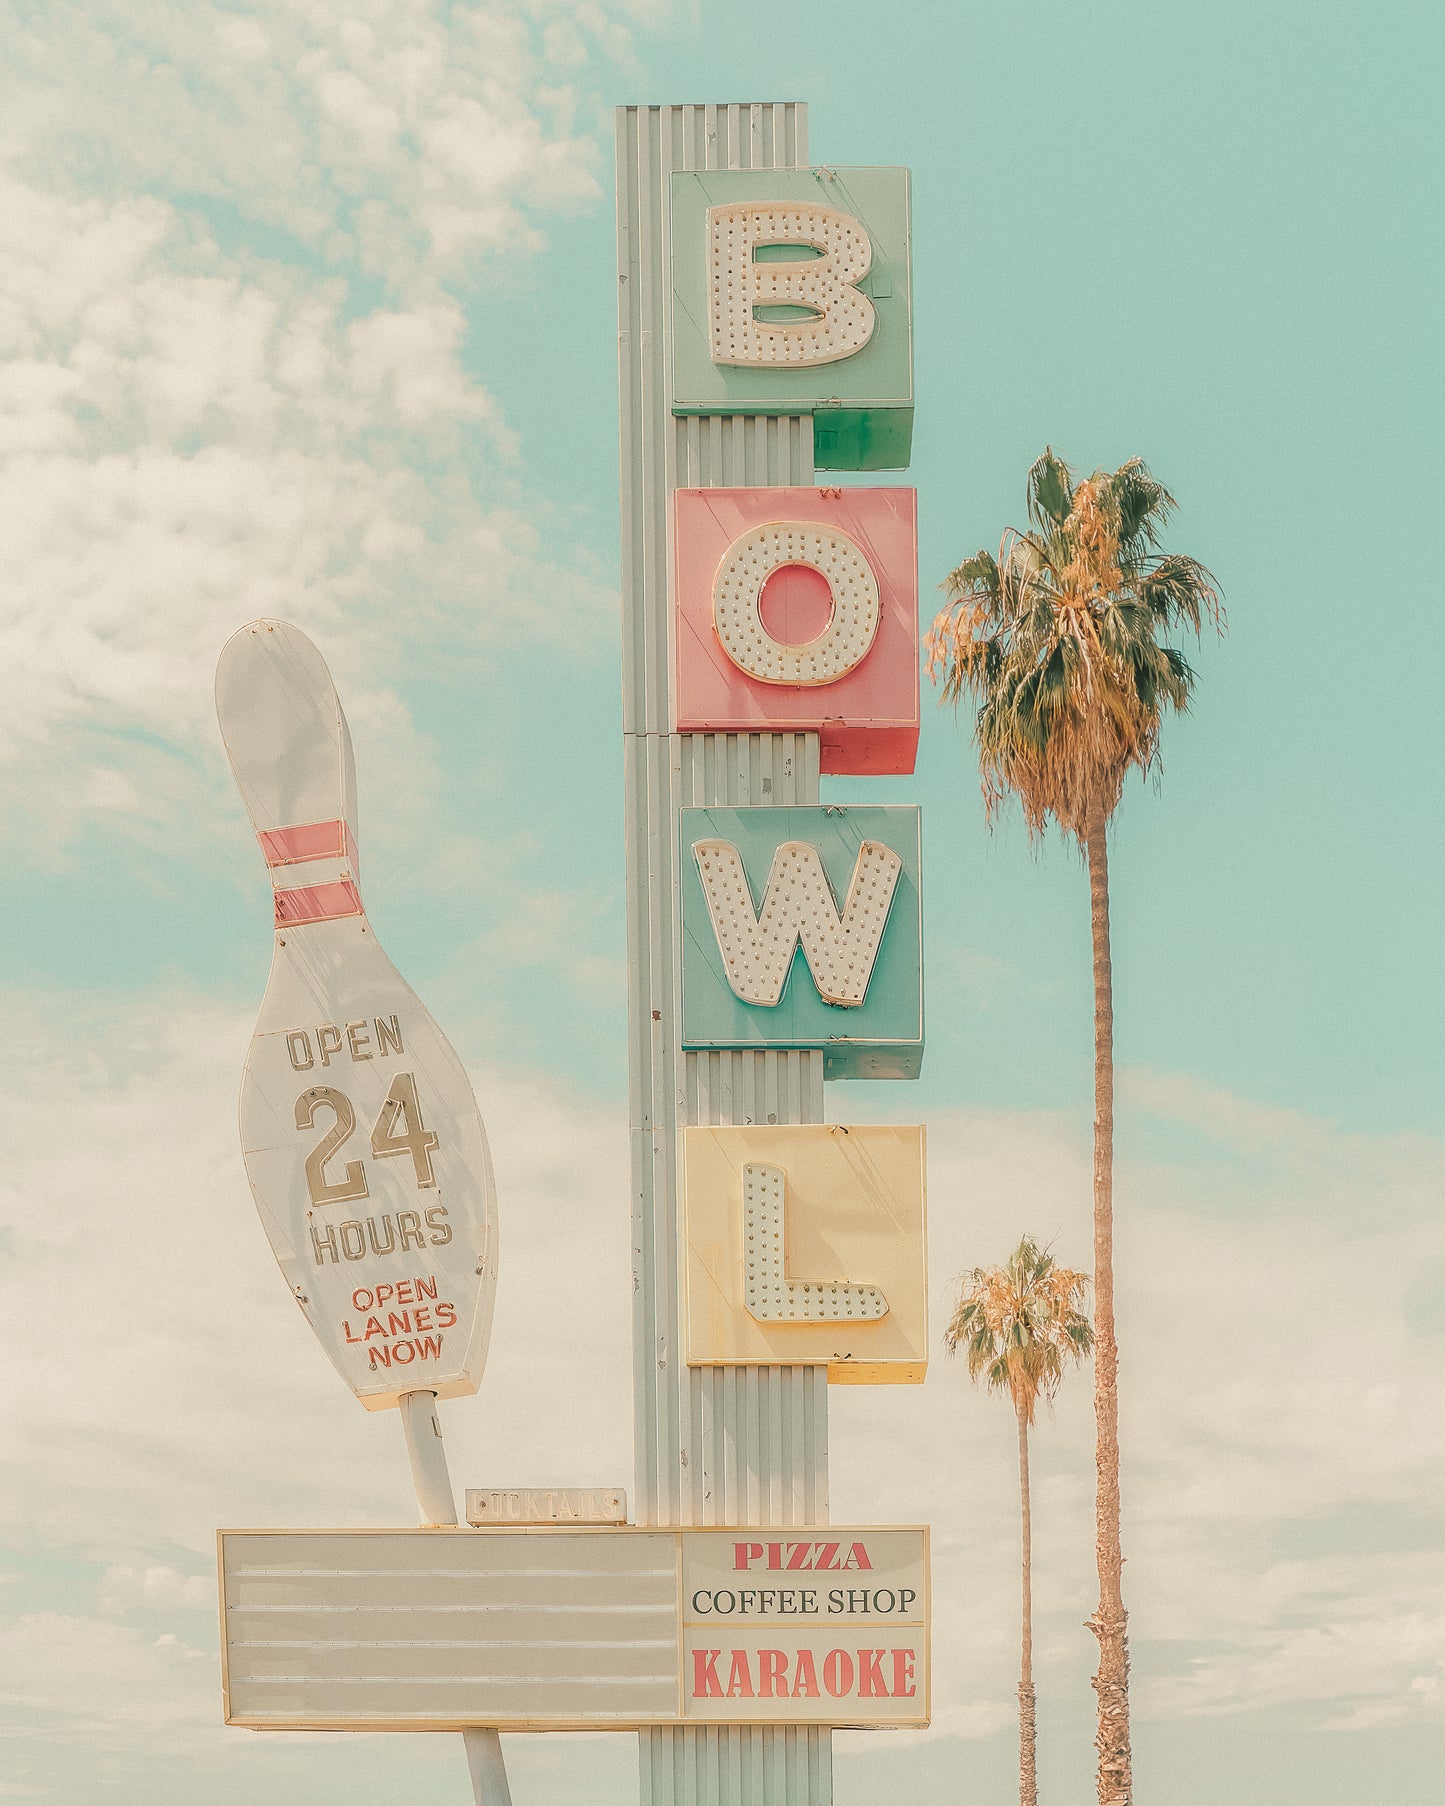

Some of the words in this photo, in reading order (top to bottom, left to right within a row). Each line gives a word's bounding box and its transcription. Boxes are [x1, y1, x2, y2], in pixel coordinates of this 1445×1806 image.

[690, 201, 903, 1324] BOWL
[285, 1014, 404, 1071] OPEN
[293, 1071, 440, 1208] 24
[309, 1206, 453, 1266] HOURS
[351, 1275, 439, 1312] OPEN
[341, 1302, 458, 1344] LANES
[367, 1335, 443, 1368] NOW
[472, 1491, 619, 1519] COCKTAILS
[732, 1542, 874, 1570] PIZZA
[692, 1590, 819, 1614] COFFEE
[827, 1588, 917, 1613] SHOP
[691, 1648, 917, 1698] KARAOKE
